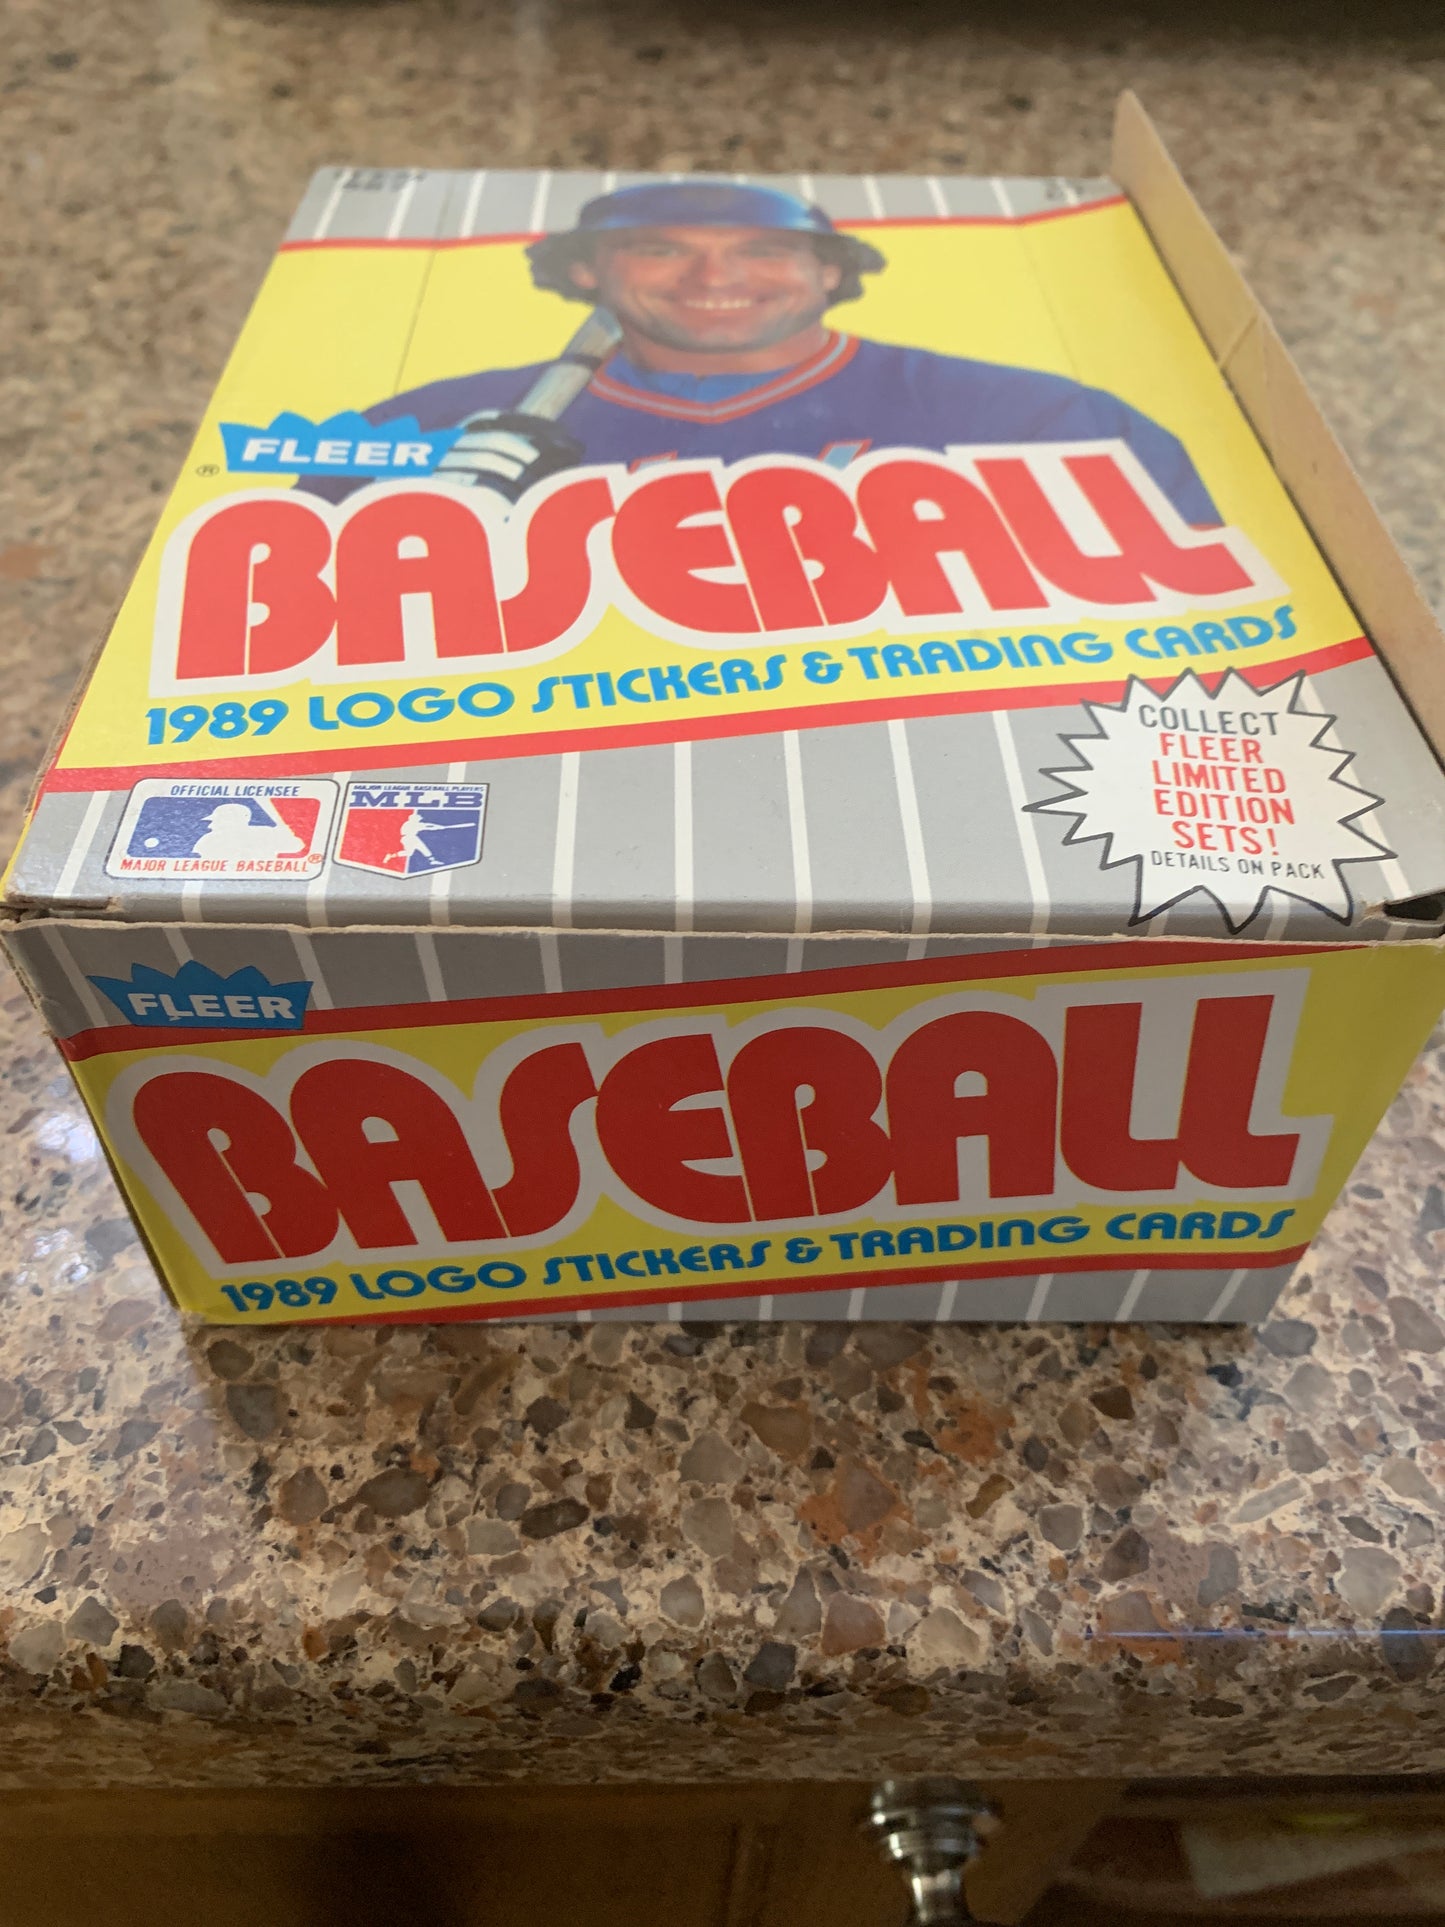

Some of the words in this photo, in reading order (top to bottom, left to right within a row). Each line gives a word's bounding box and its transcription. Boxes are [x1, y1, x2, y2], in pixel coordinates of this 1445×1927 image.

[241, 437, 433, 467] FLEER
[176, 455, 1254, 680] BASEBALL
[145, 697, 290, 746] 1989
[309, 682, 515, 731] LOGO
[531, 654, 787, 714] STICKERS
[801, 651, 844, 686] &
[847, 627, 1114, 680] TRADING
[1124, 605, 1297, 660] CARDS
[1138, 704, 1280, 736] COLLECT
[1159, 732, 1264, 763] FLEER
[170, 784, 230, 797] OFFICIAL
[234, 785, 301, 797] LICENSEE
[1151, 759, 1287, 794] LIMITED
[350, 791, 484, 808] MLB
[1153, 788, 1296, 825] EDITION
[1171, 820, 1280, 856] SETS!
[120, 859, 166, 872] MAJOR
[173, 859, 229, 872] LEAGUE
[235, 860, 310, 873] BASEBALL
[1151, 850, 1230, 873] DETAILS
[1237, 858, 1265, 876] ON
[1270, 861, 1326, 880] PACK
[127, 992, 297, 1020] FLEER
[133, 993, 1300, 1264] BASEBALL
[221, 1277, 338, 1312] 1989
[351, 1262, 527, 1300] LOGO
[543, 1241, 771, 1285] STICKERS
[785, 1237, 823, 1265] &
[830, 1216, 1090, 1261] TRADING
[1105, 1209, 1295, 1241] CARDS
